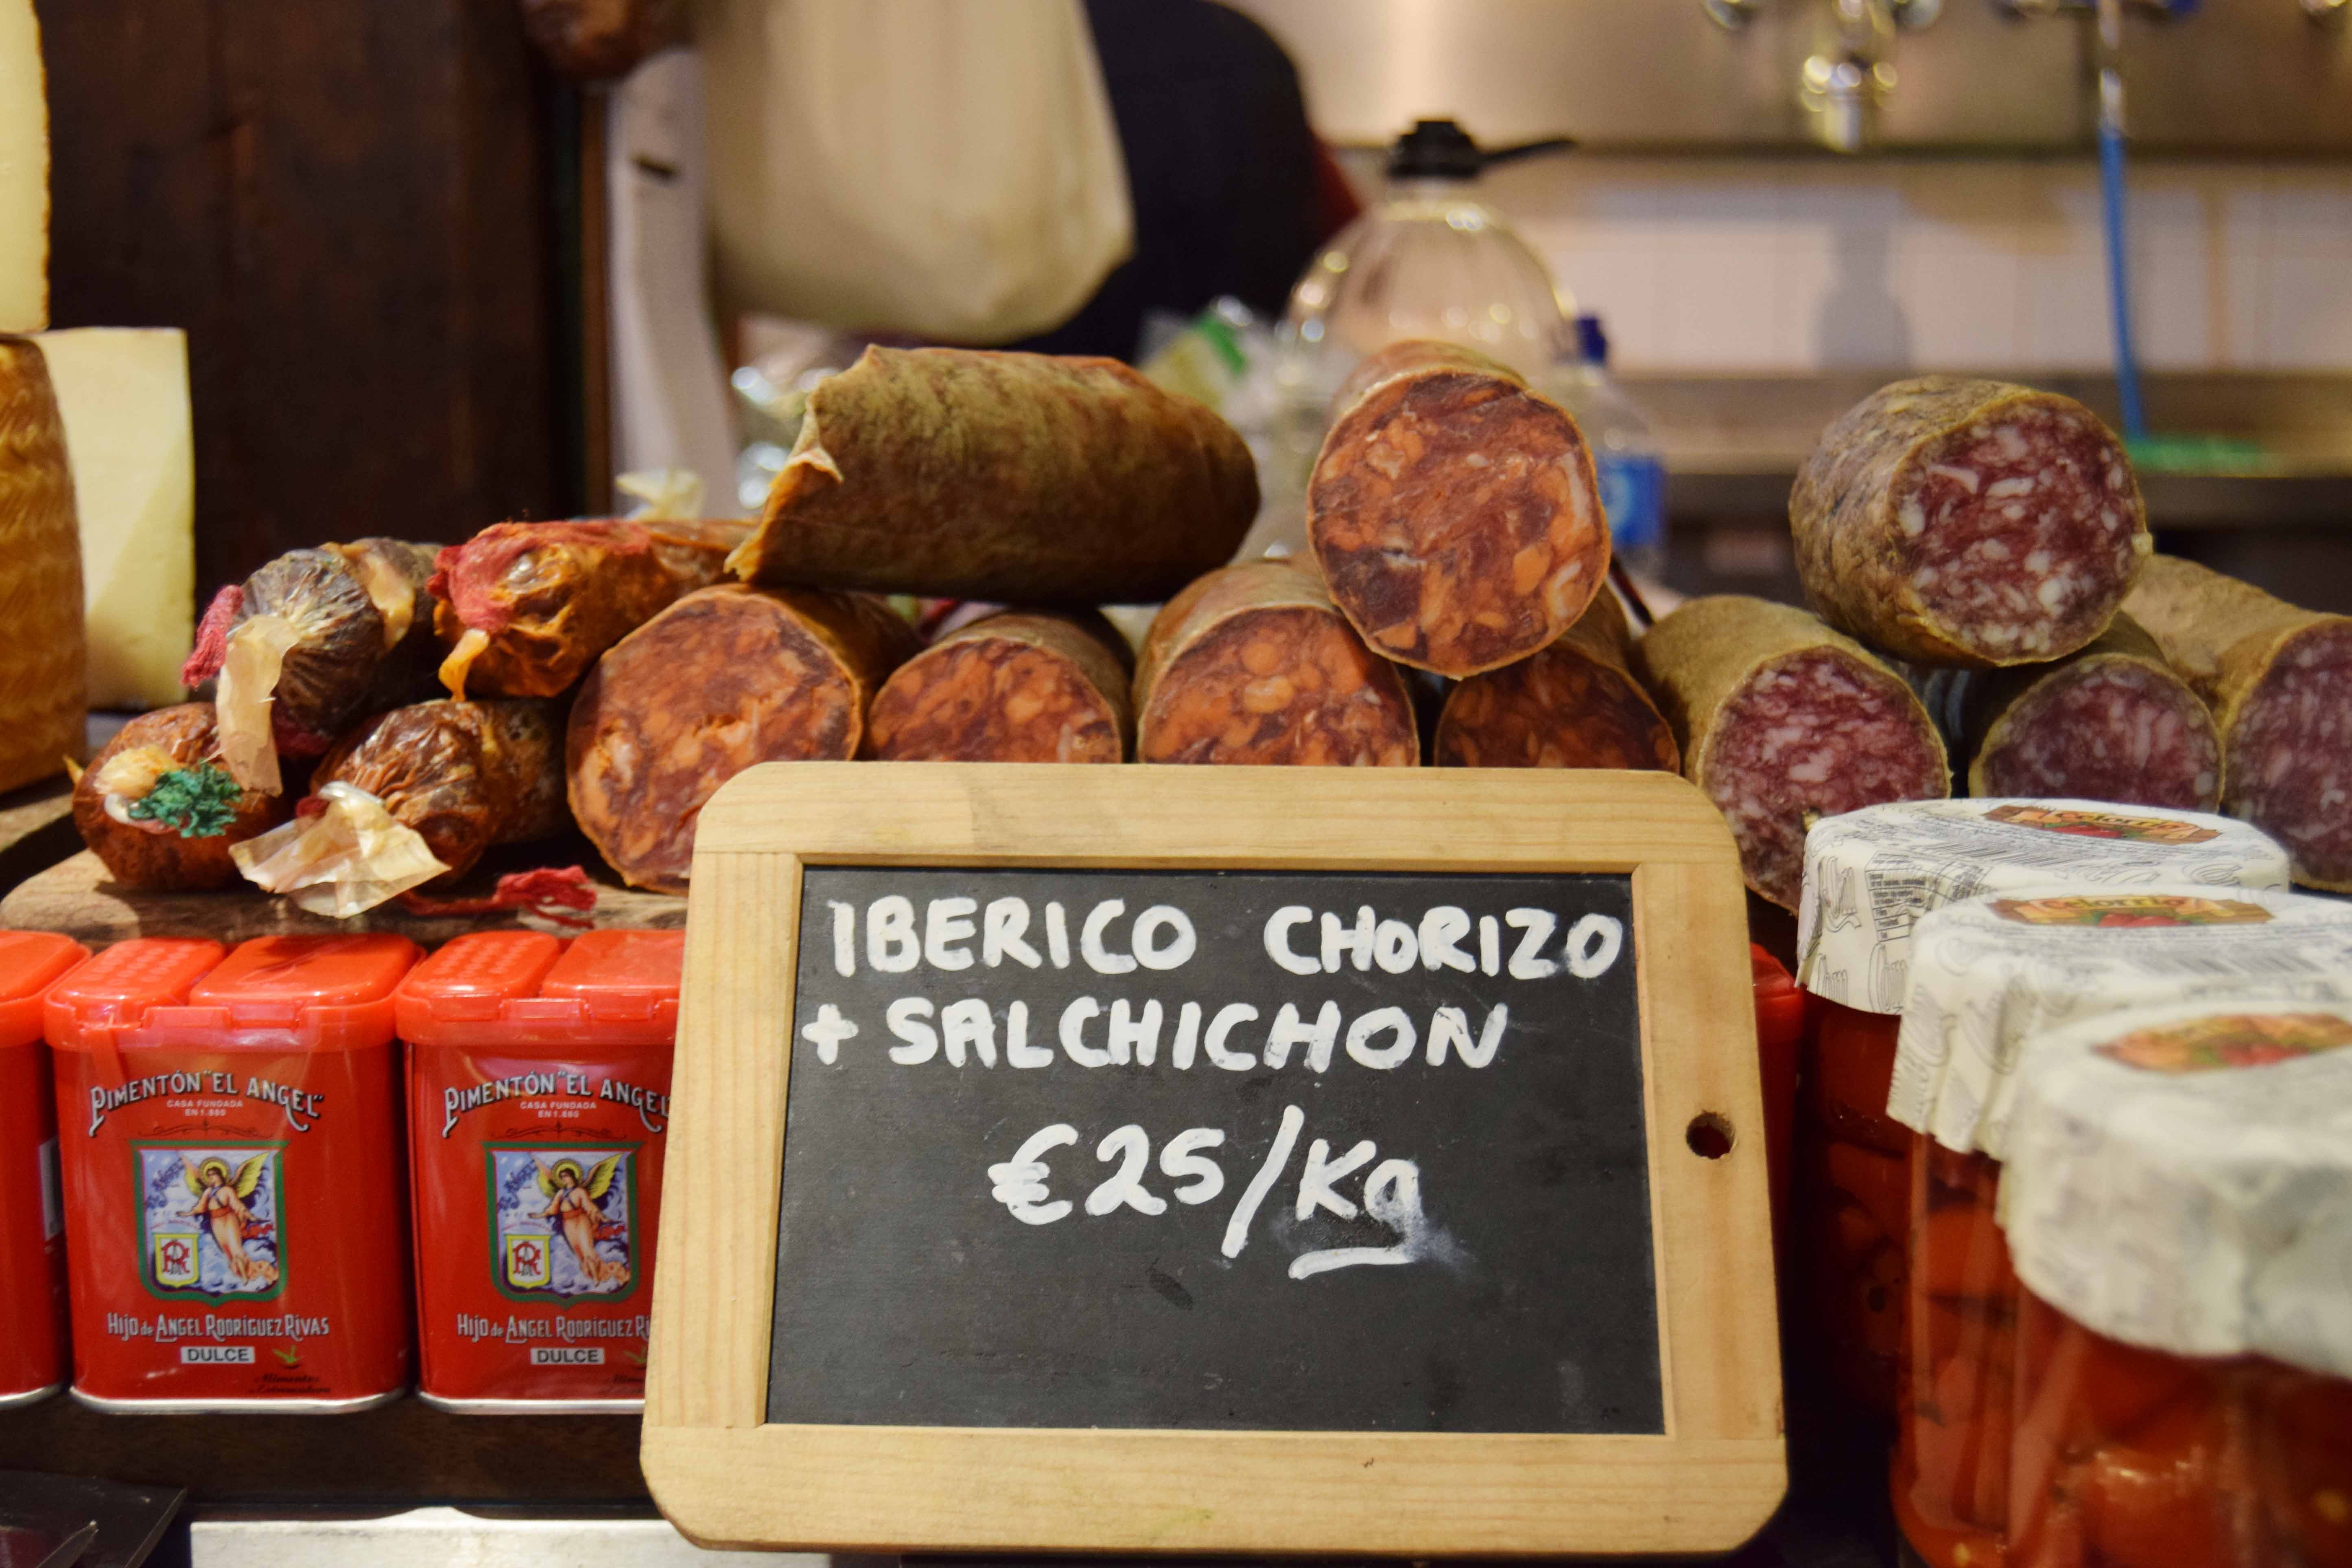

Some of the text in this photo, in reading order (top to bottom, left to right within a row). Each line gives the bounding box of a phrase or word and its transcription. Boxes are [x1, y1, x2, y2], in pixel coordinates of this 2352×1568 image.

[827, 895, 1623, 980] IBERICO CHORIZO
[801, 996, 1508, 1072] + SALCHICHON
[88, 1069, 202, 1137] PIMENTÓN
[441, 1070, 555, 1138] PIMENTÓN
[520, 1101, 597, 1109] CASA FUNDADA
[140, 1321, 155, 1336] de
[155, 1314, 203, 1343] ANGEL
[490, 1322, 504, 1337] de
[505, 1315, 553, 1343] ANGEL
[188, 1349, 250, 1362] DULCE
[537, 1349, 599, 1363] DULCE
